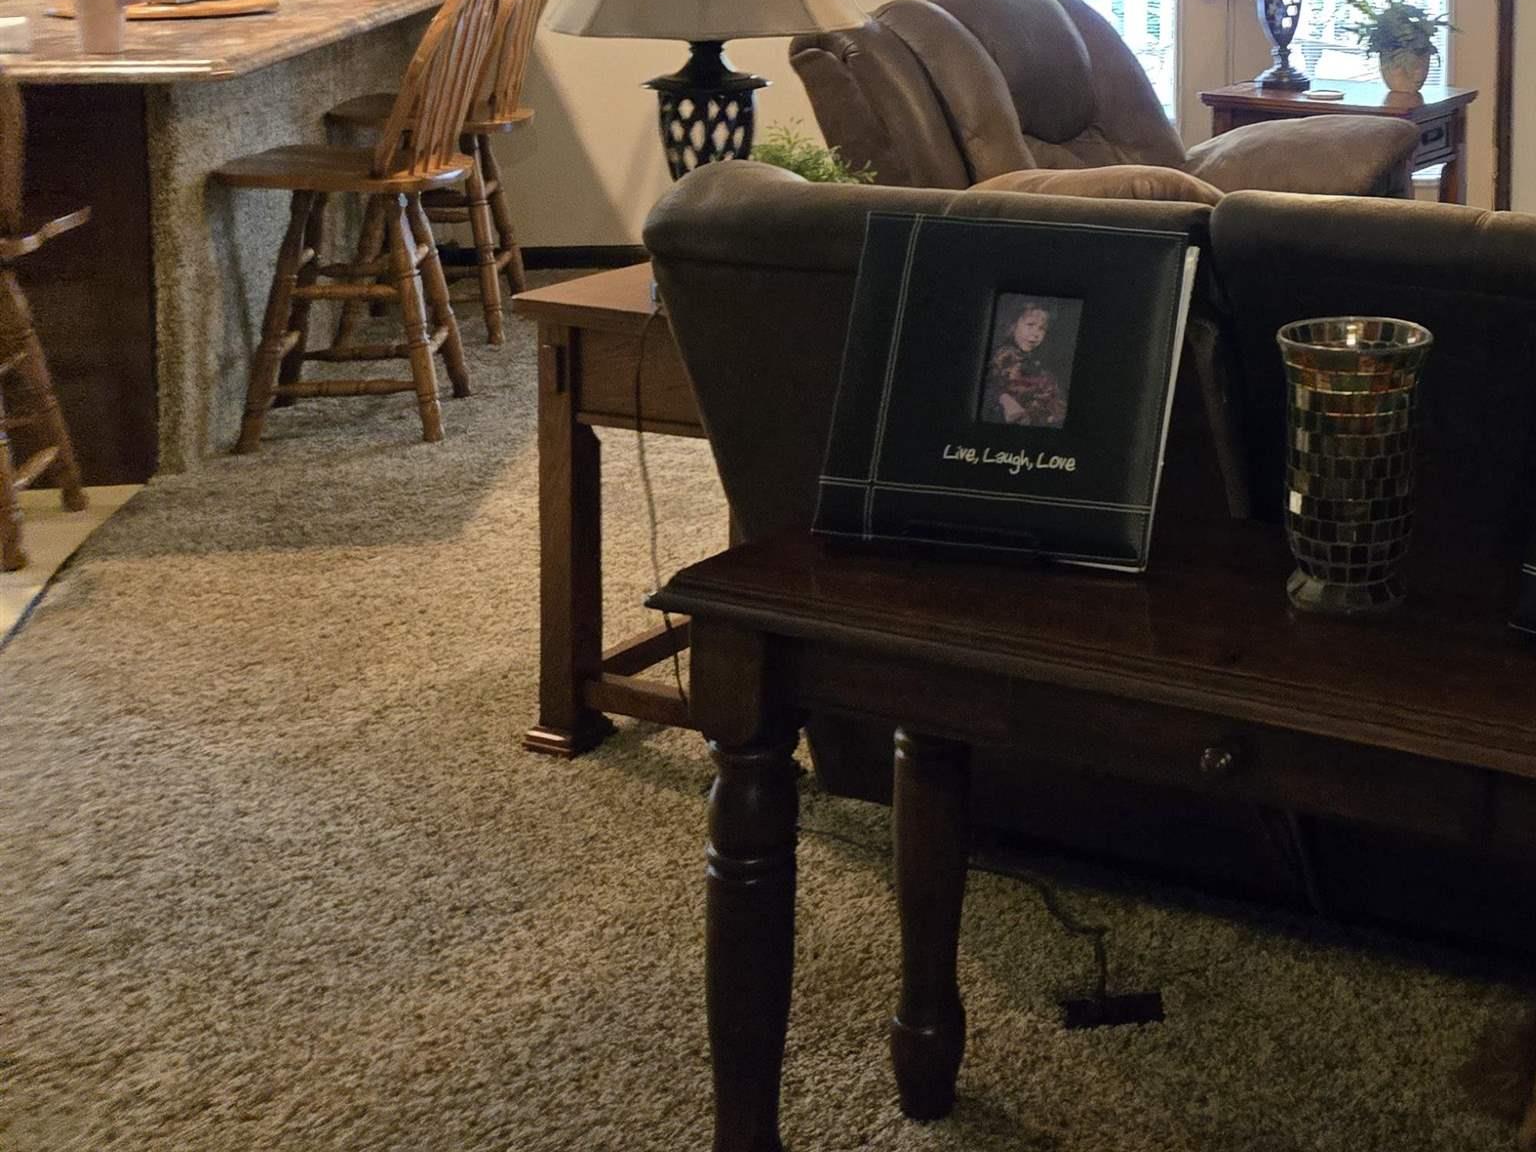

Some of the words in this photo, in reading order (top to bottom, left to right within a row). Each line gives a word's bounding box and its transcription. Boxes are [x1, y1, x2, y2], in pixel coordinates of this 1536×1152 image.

[943, 444, 979, 464] Live,
[982, 448, 1033, 474] Laugh,
[1036, 452, 1076, 471] Love
